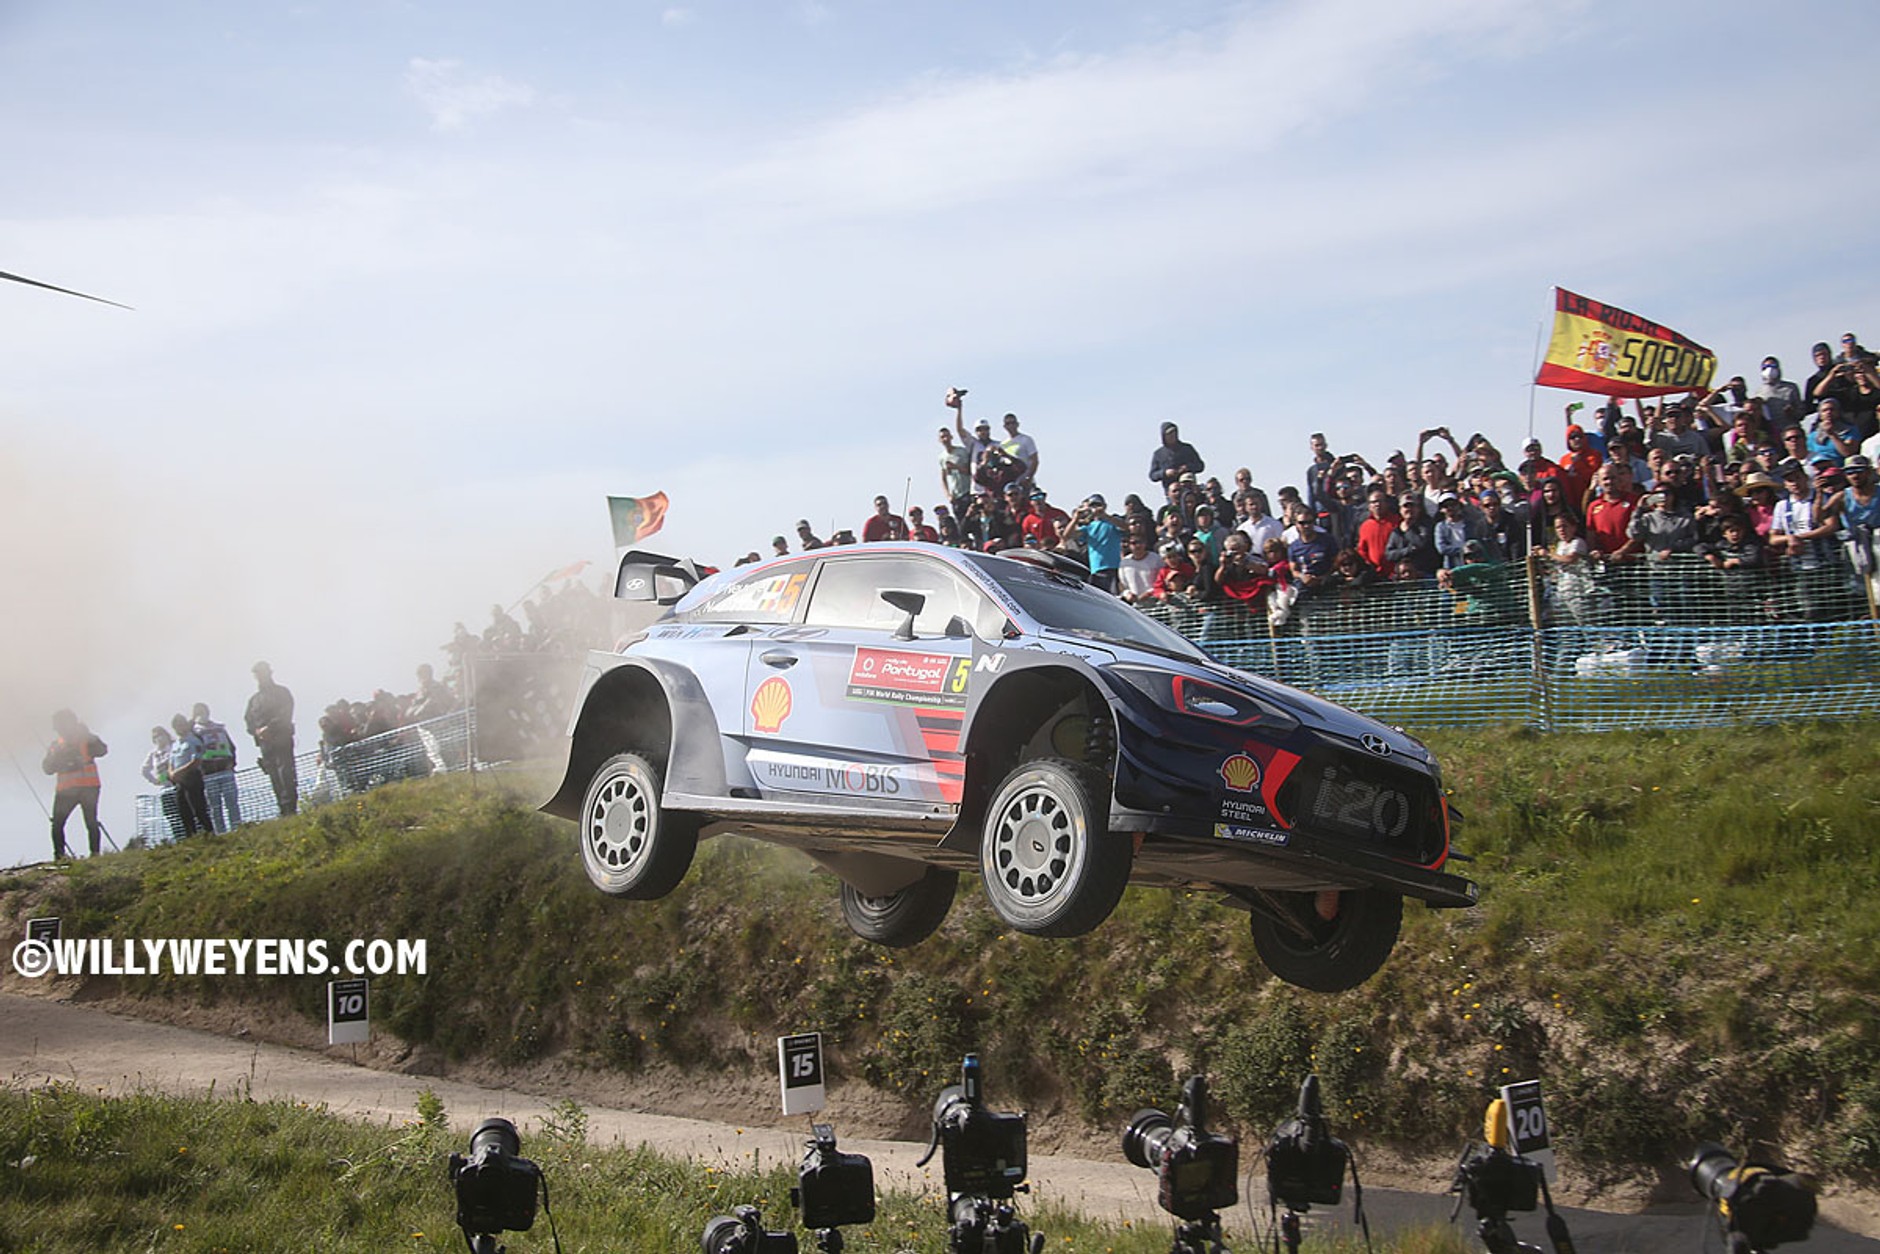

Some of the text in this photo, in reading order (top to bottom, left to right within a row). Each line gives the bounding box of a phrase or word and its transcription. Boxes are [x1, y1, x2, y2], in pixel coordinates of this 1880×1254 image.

[1564, 293, 1589, 315] LA
[776, 573, 808, 615] 5
[881, 663, 942, 680] Portugal
[952, 659, 972, 693] 5
[768, 763, 901, 794] HYUNDAI MOBIS
[1222, 800, 1266, 814] HYUNDAI
[1313, 766, 1409, 837] i20
[1221, 809, 1252, 821] STEEL
[1235, 829, 1286, 842] MICHELIN
[338, 995, 364, 1015] 10
[791, 1052, 815, 1078] 15
[1517, 1106, 1543, 1140] 20
